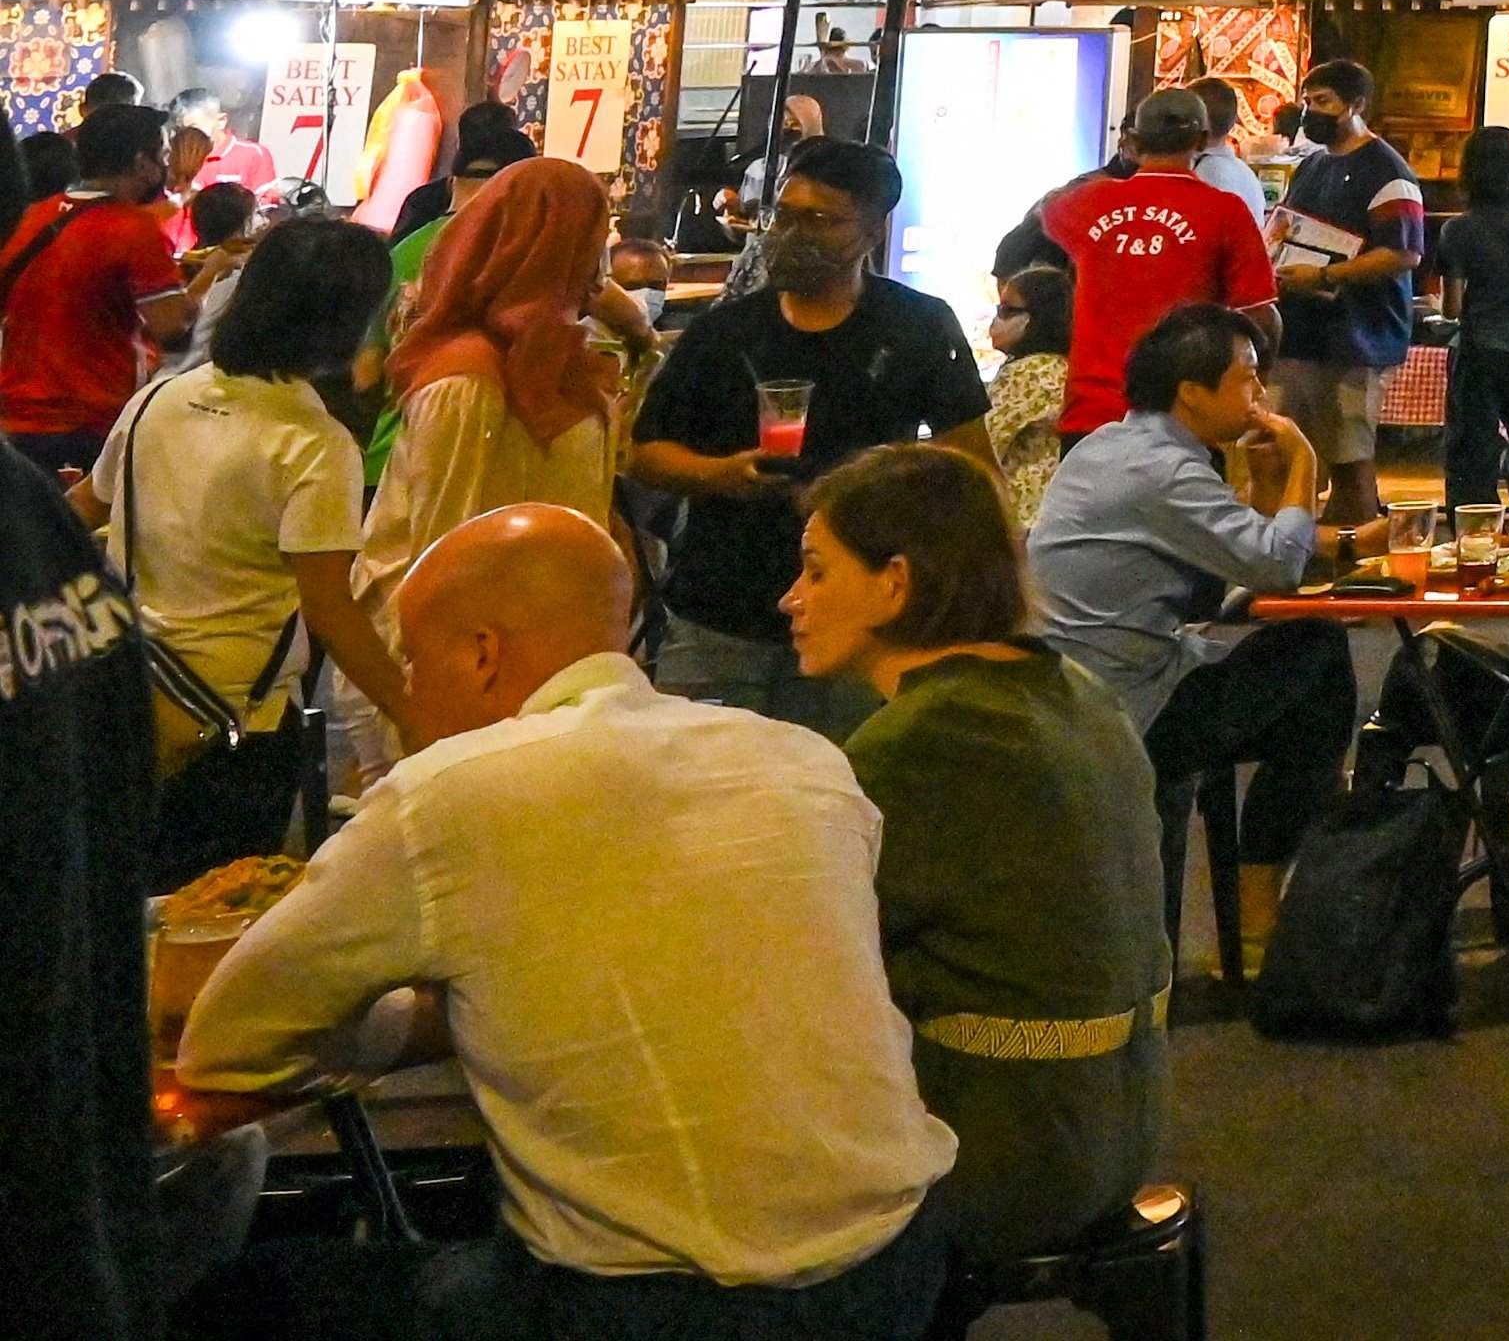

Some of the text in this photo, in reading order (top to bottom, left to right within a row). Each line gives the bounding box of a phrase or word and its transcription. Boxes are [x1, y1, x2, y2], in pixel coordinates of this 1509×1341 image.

[565, 35, 617, 56] BEST
[286, 60, 357, 80] BET
[555, 60, 622, 82] SATAY
[570, 88, 603, 159] 7
[291, 116, 325, 183] 7
[1088, 206, 1196, 244] BEST SATAY
